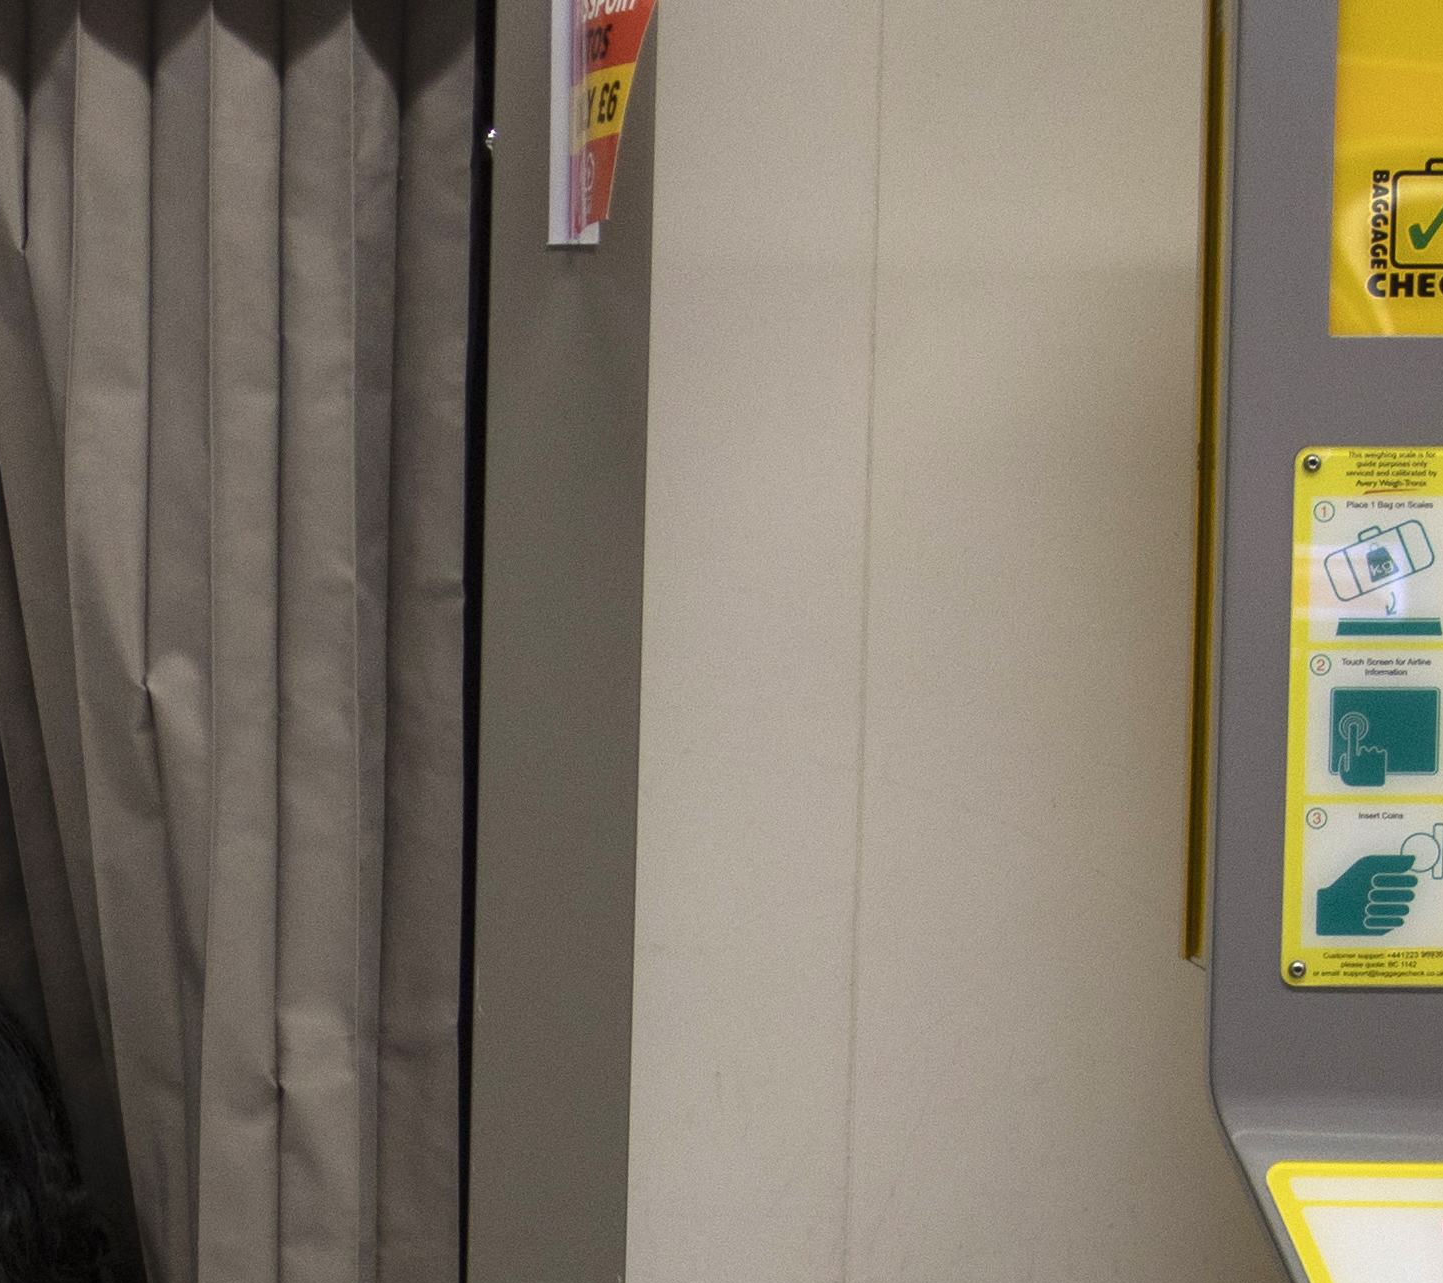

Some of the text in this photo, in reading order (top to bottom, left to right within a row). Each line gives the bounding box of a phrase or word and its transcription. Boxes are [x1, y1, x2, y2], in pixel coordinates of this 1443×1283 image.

[1370, 169, 1390, 270] BAGGAGE
[1345, 500, 1368, 508] Place
[1377, 500, 1393, 509] Bag
[1369, 558, 1395, 577] kg
[1316, 658, 1325, 672] 2
[1341, 657, 1431, 666] Touch Screen for Airline
[1312, 811, 1321, 824] 3
[1357, 811, 1379, 819] Insert
